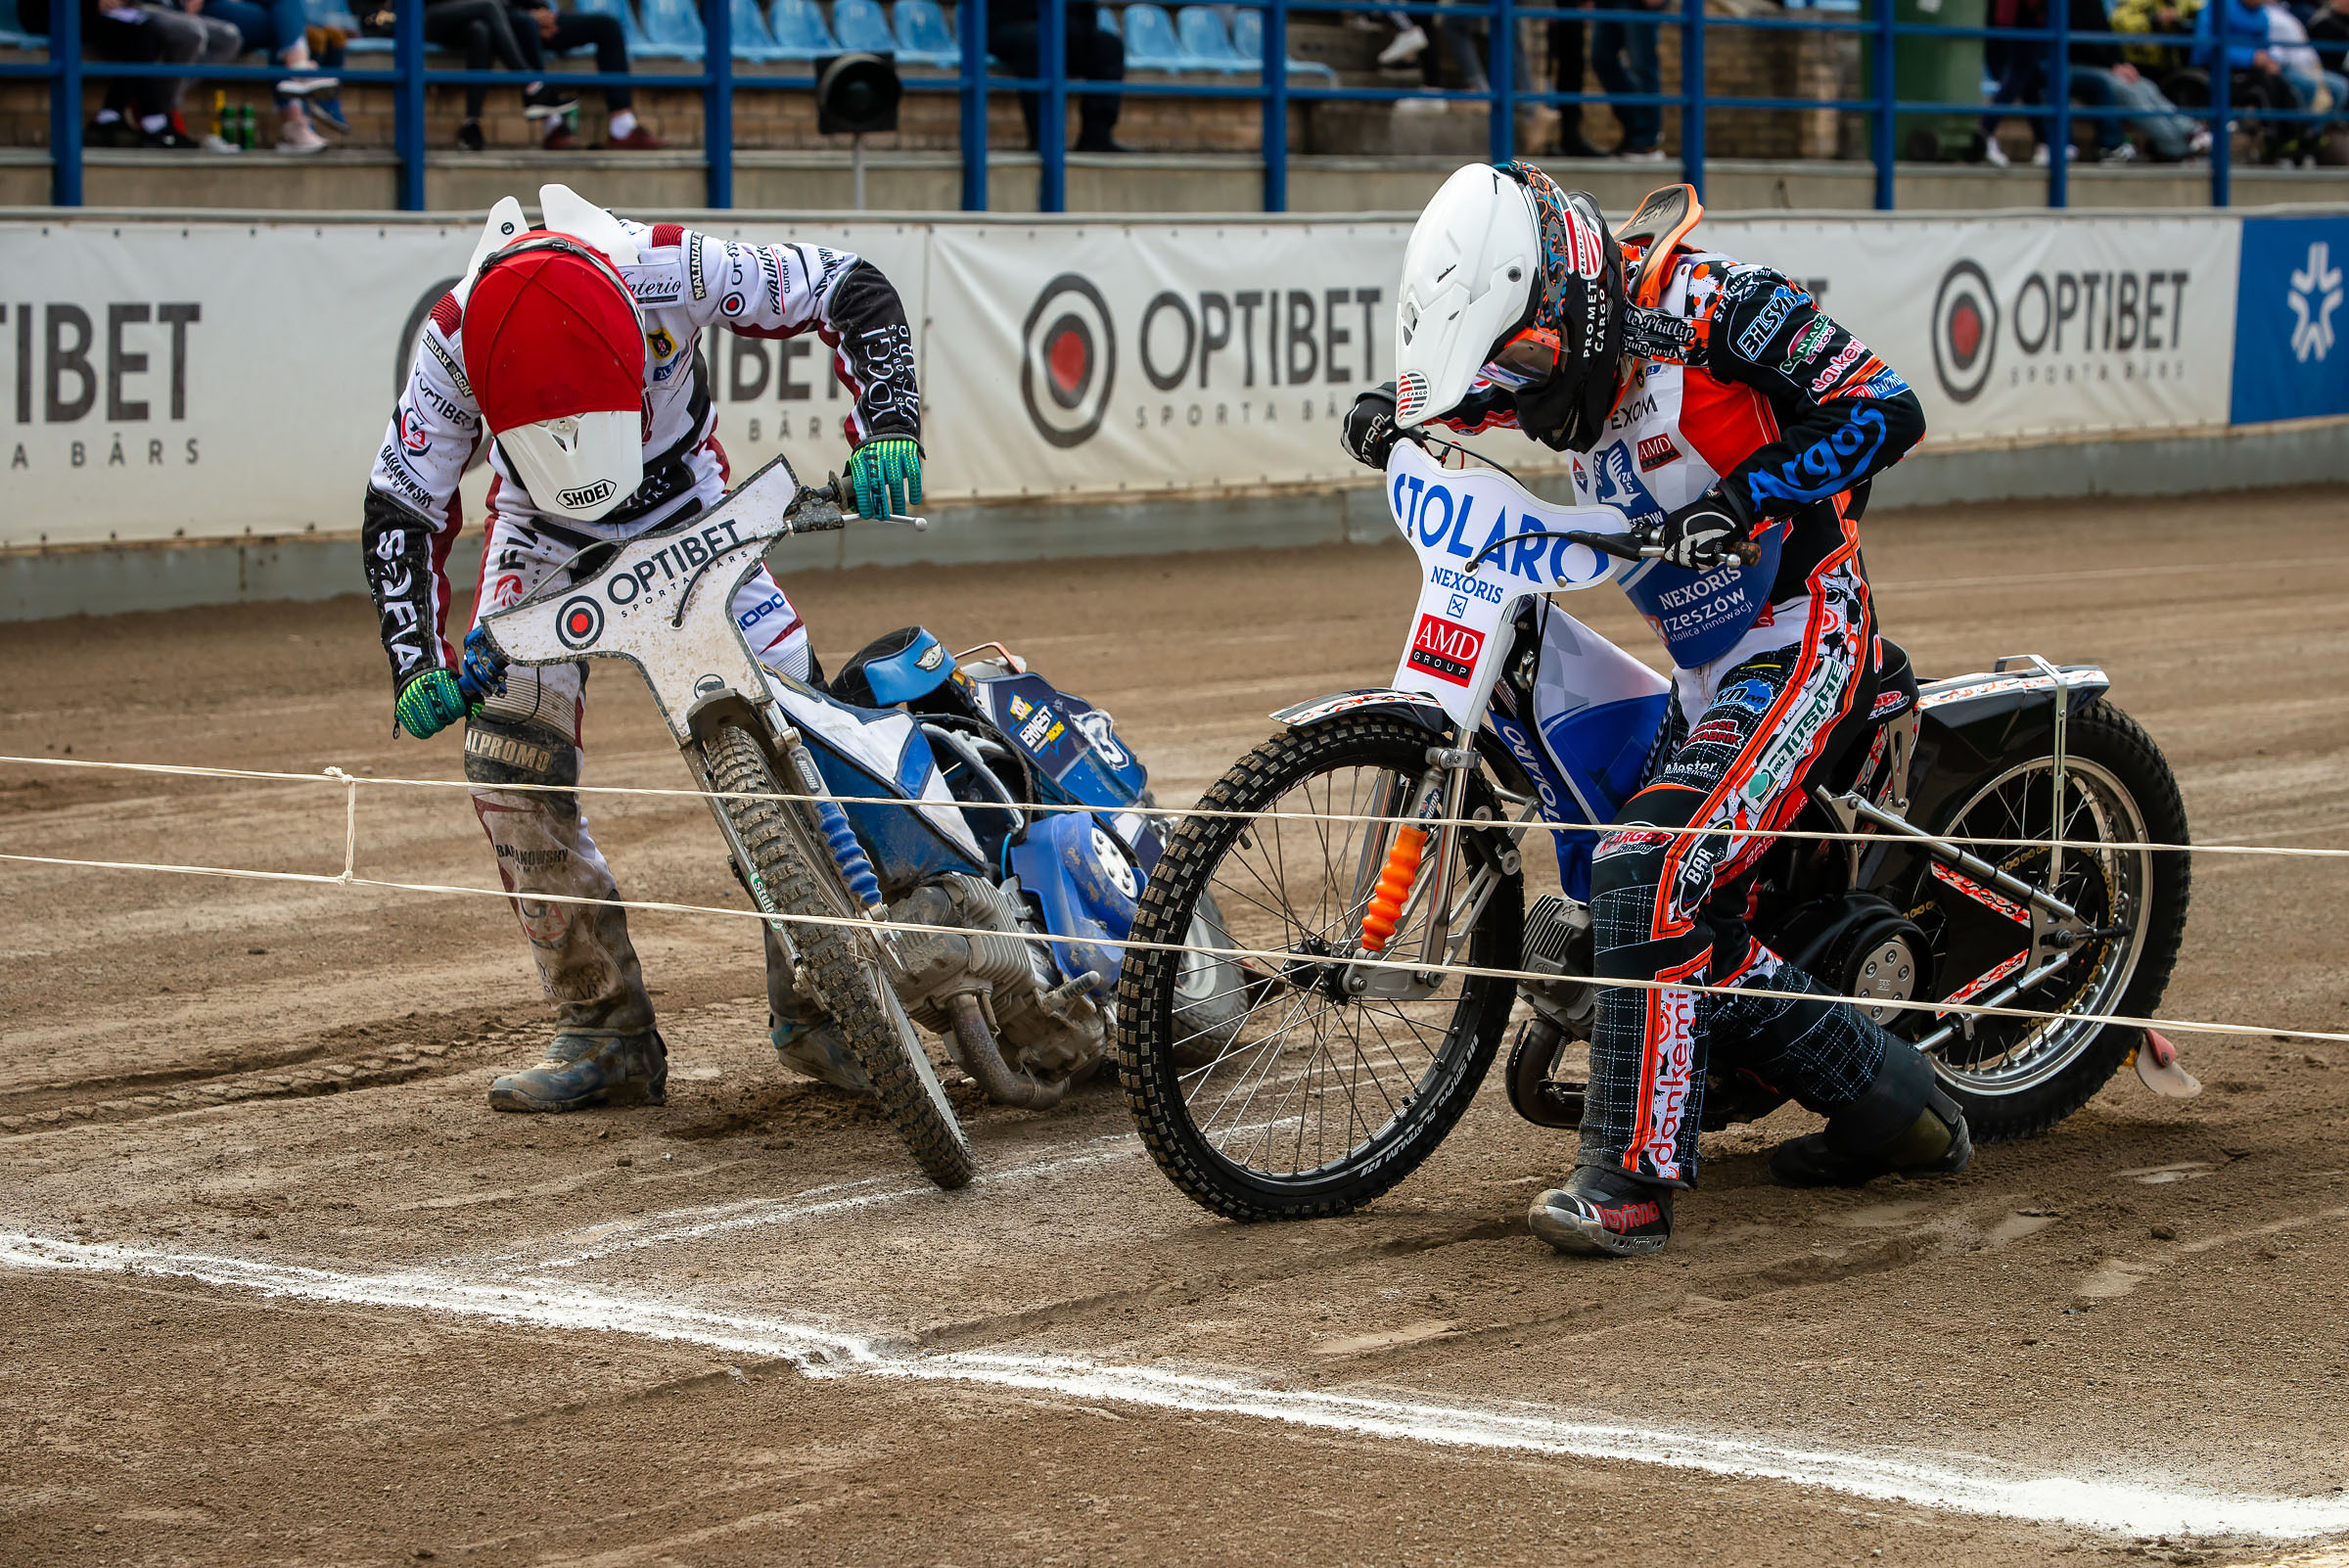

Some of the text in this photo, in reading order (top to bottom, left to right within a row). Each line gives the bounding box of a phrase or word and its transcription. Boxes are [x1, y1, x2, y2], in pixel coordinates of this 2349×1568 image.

[1584, 281, 1597, 358] PROMET
[1594, 289, 1606, 352] CARGO
[2013, 270, 2189, 355] OPTIBET
[1139, 288, 1382, 391] OPTIBET
[1625, 339, 1676, 360] ransport
[0, 302, 201, 424] IBET
[1135, 395, 1340, 428] SPORTA BĀ
[1639, 437, 1672, 460] AMD
[563, 482, 611, 507] SHOEI
[607, 519, 741, 605] OPTIBET
[1431, 565, 1504, 605] NEXORIS
[1658, 567, 1742, 611] NEXORIS
[1415, 620, 1479, 661] AMD
[1413, 650, 1468, 676] GROUP
[1019, 705, 1055, 748] ERNEST
[1777, 660, 1844, 756] TUSCHE
[1773, 753, 1788, 776] HOLZ
[1686, 848, 1715, 886] BAR
[1648, 991, 1689, 1166] dankemi
